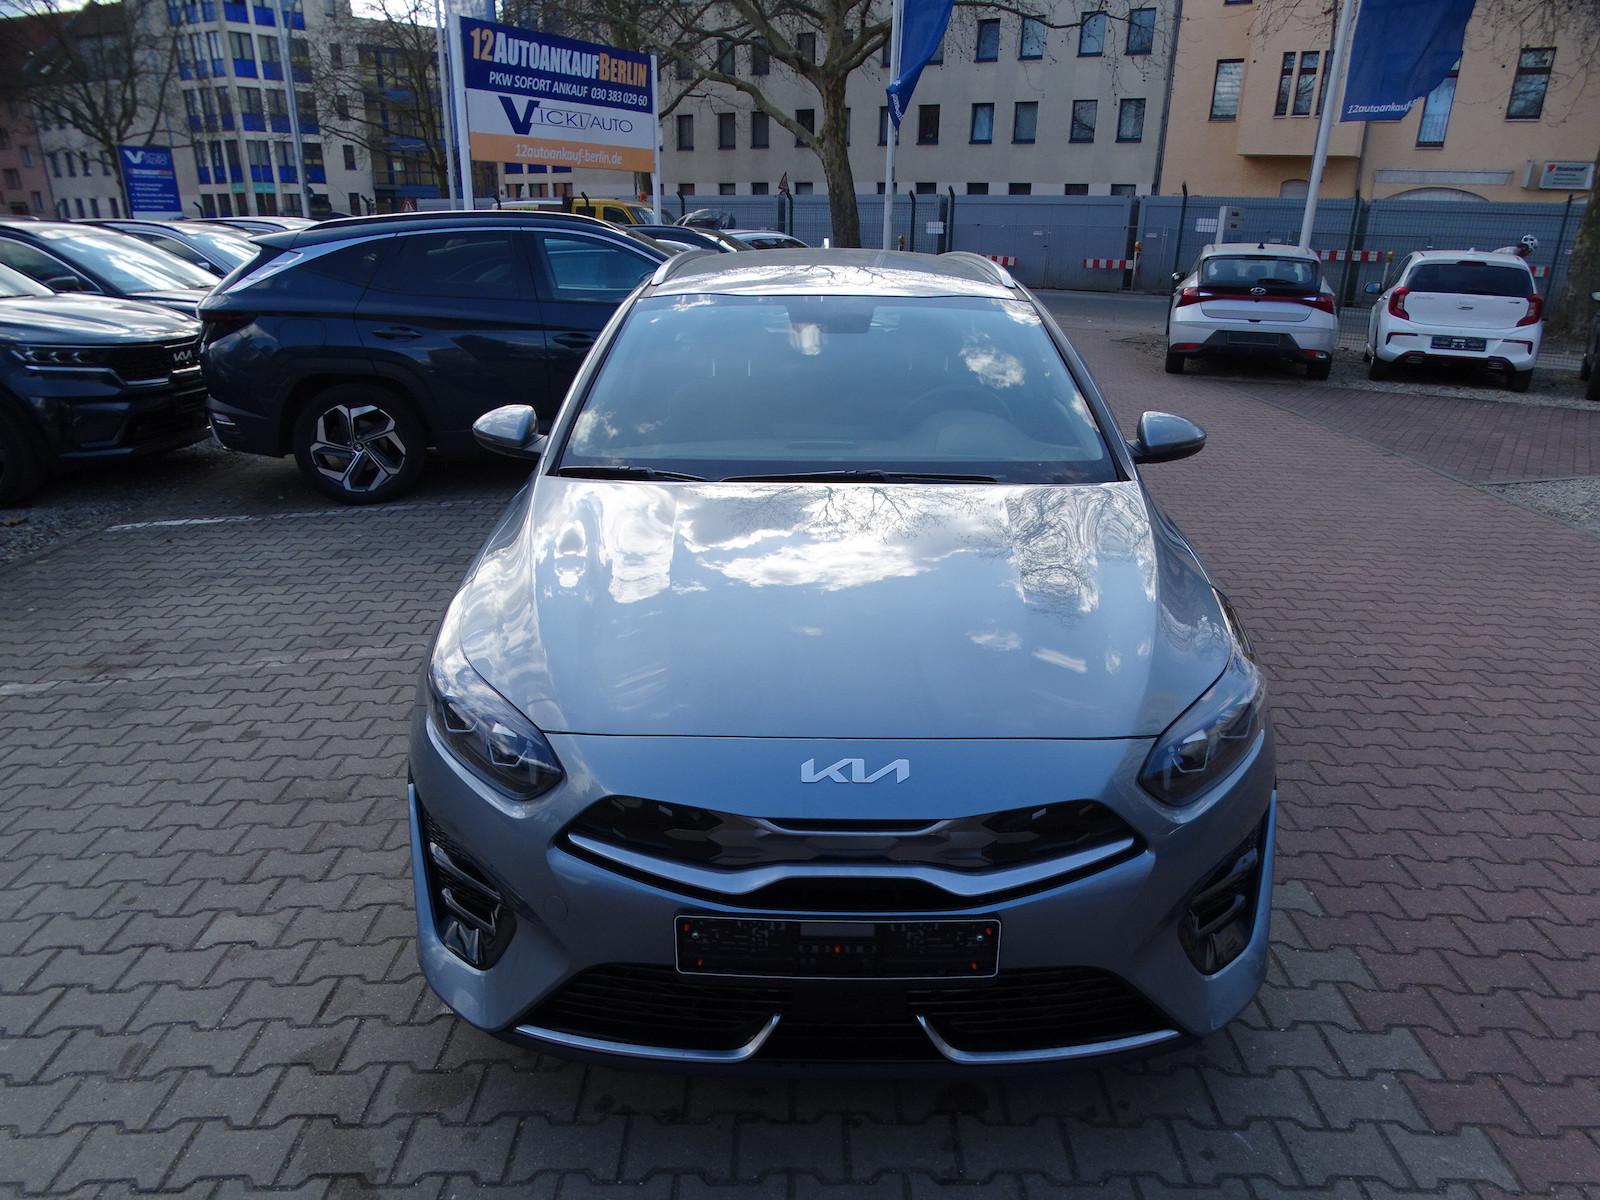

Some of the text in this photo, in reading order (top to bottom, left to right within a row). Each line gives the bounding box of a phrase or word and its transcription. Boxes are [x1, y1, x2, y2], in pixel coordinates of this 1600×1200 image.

[489, 71, 648, 107] PKW SOFORT ANKAUF 030 383 029 60
[515, 143, 623, 165] 12autoankauf-berlin.de
[173, 350, 193, 362] KIA
[800, 758, 910, 784] KIA
